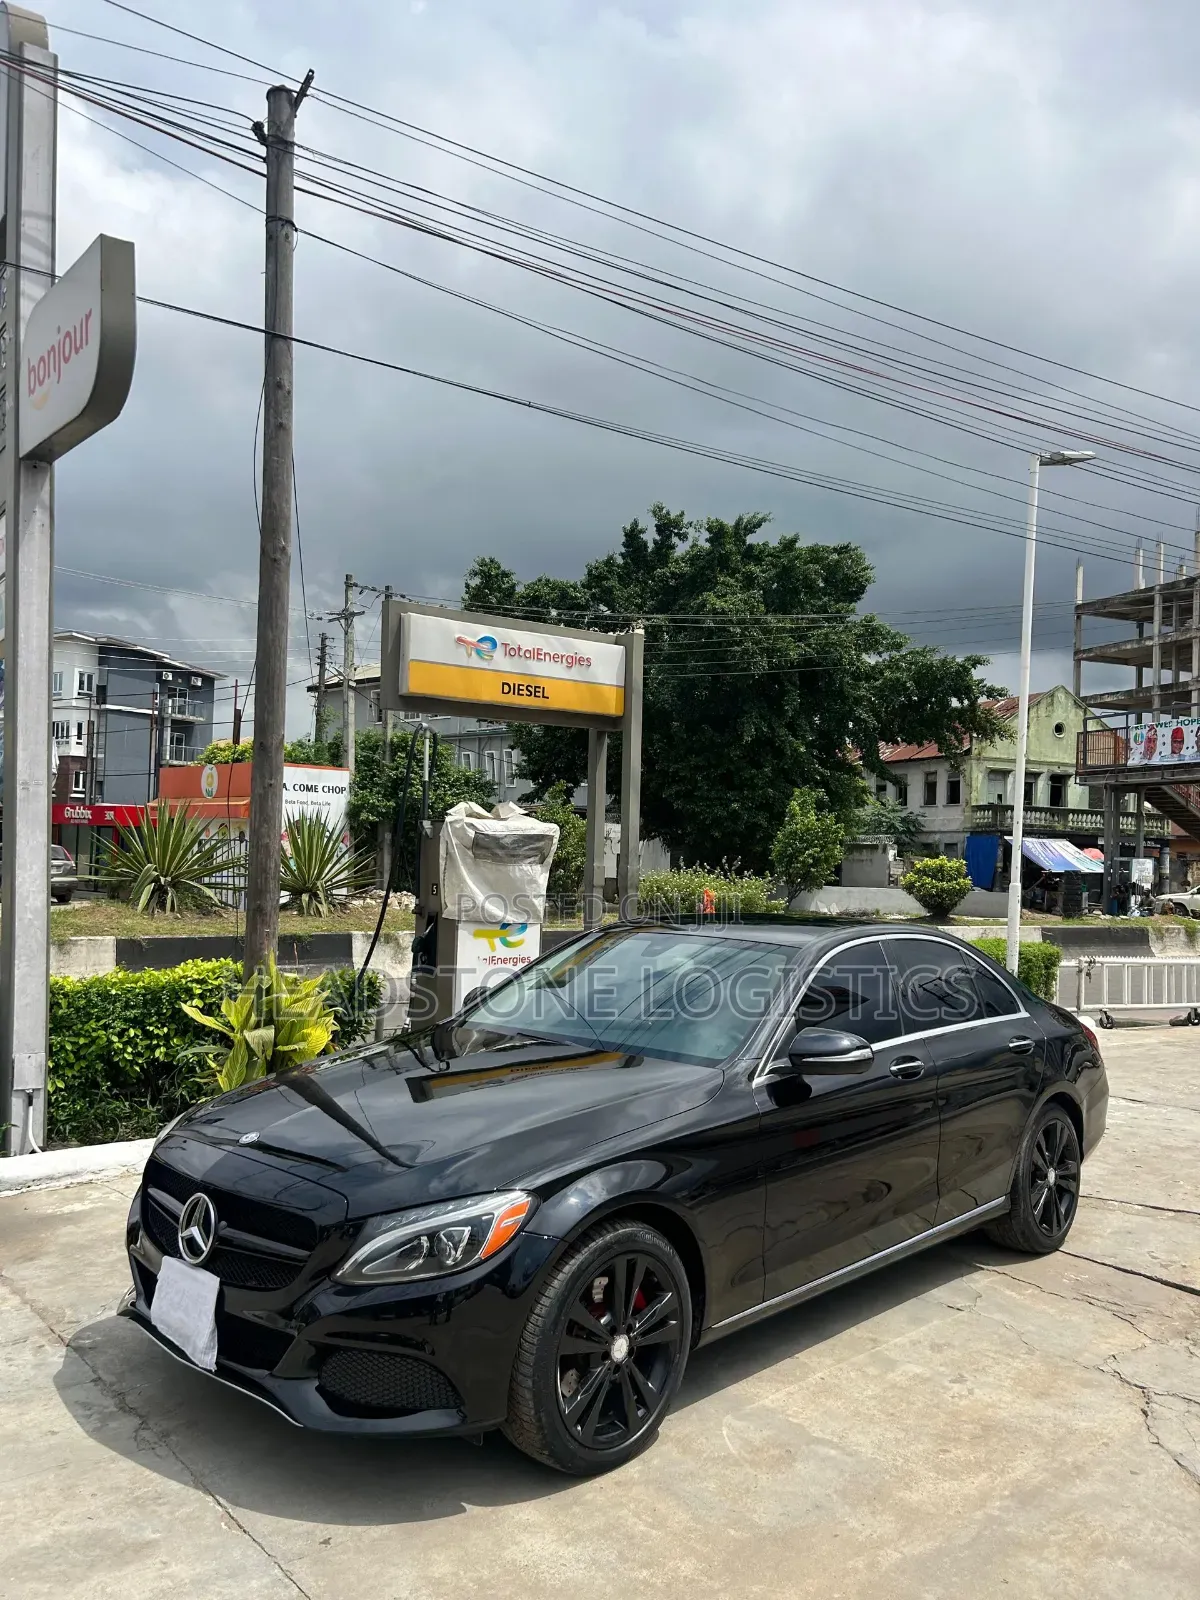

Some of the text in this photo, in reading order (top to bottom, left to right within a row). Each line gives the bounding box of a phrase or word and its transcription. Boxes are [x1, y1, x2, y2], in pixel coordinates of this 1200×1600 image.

[28, 307, 93, 398] bonjour
[501, 642, 592, 668] TotalEnergies
[501, 681, 550, 700] DIESEL
[293, 783, 319, 793] COME
[321, 785, 347, 795] CHOP
